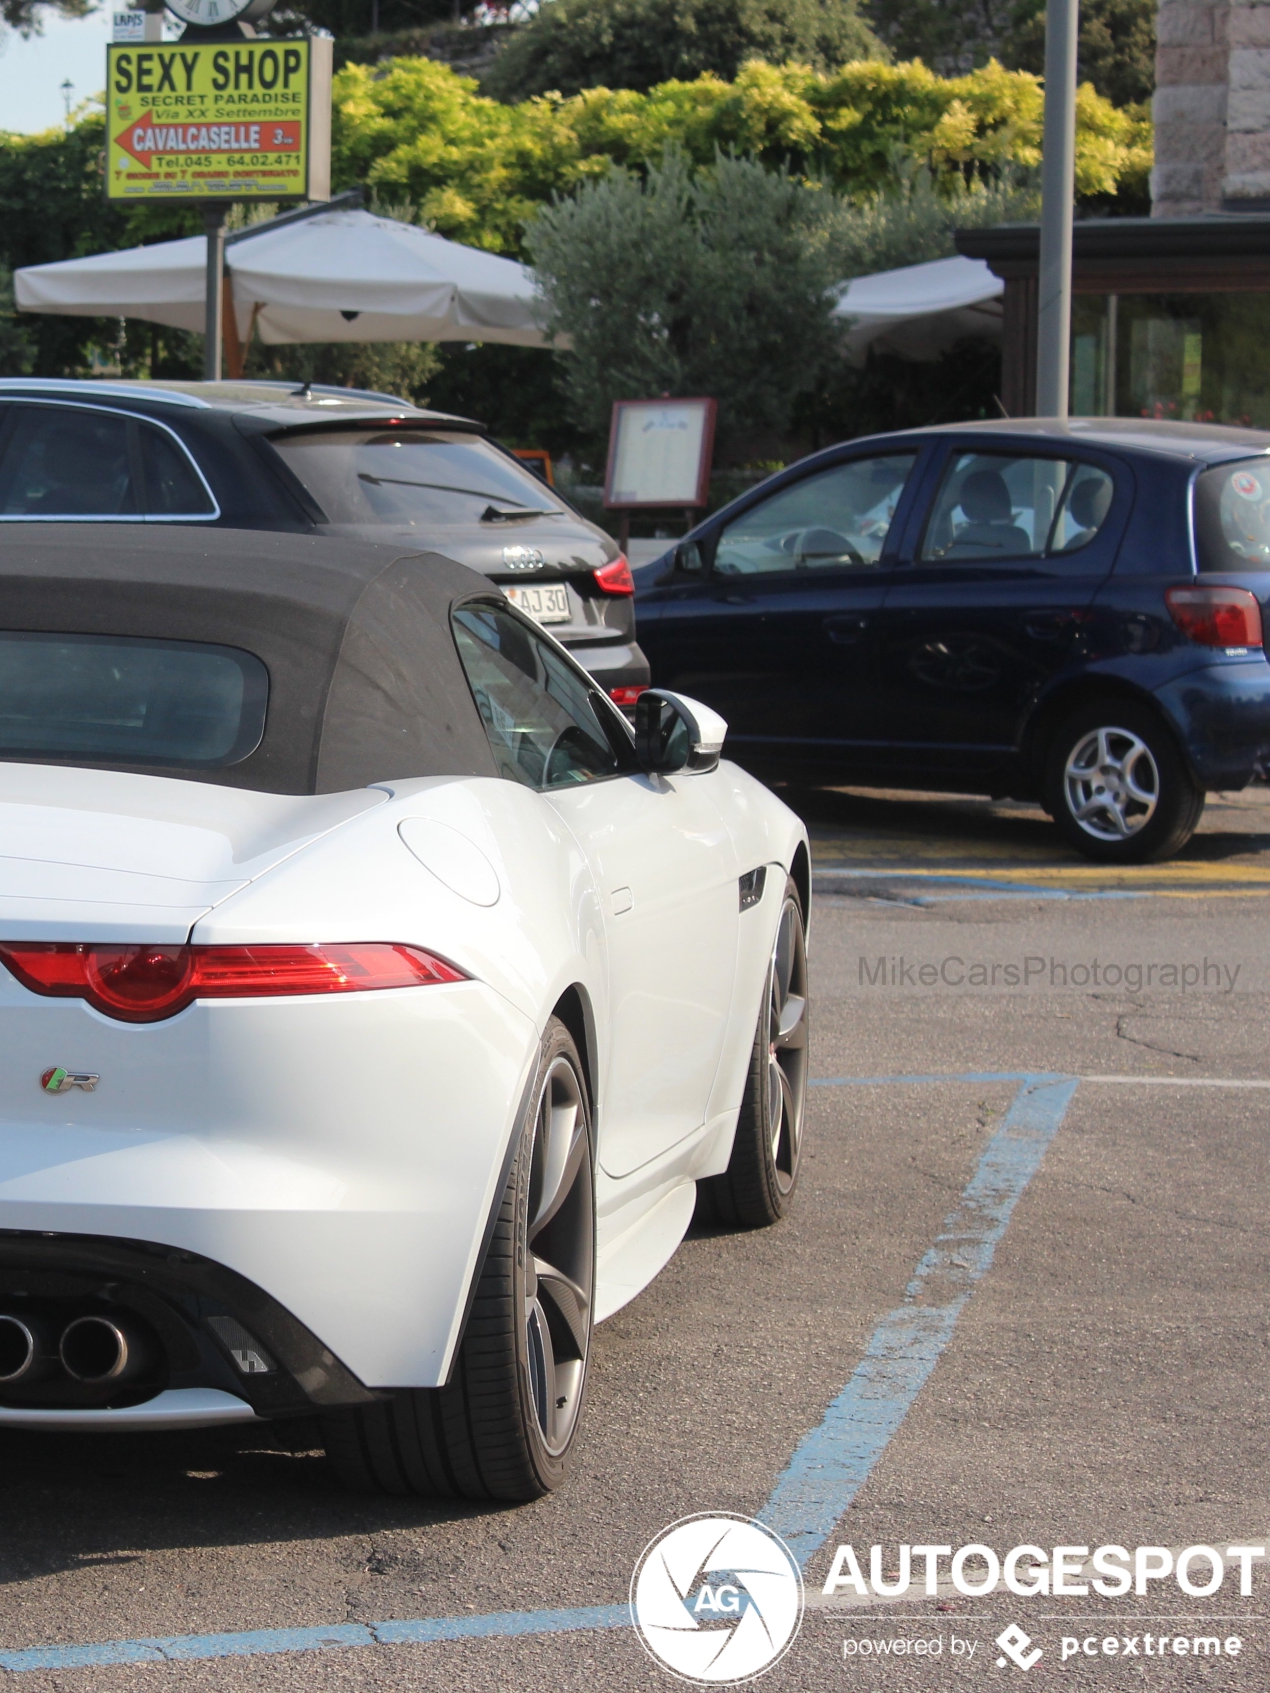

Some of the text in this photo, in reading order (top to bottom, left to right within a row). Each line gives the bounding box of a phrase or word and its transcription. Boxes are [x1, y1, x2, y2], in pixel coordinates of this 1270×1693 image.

[114, 49, 301, 94] SEXY SHOP
[140, 92, 301, 107] SECRET PARADISE
[154, 107, 301, 120] Via XX Settembre
[133, 125, 260, 152] CAVALCASELLE
[156, 156, 212, 169] Tel.045
[226, 154, 300, 167] 64.02.471
